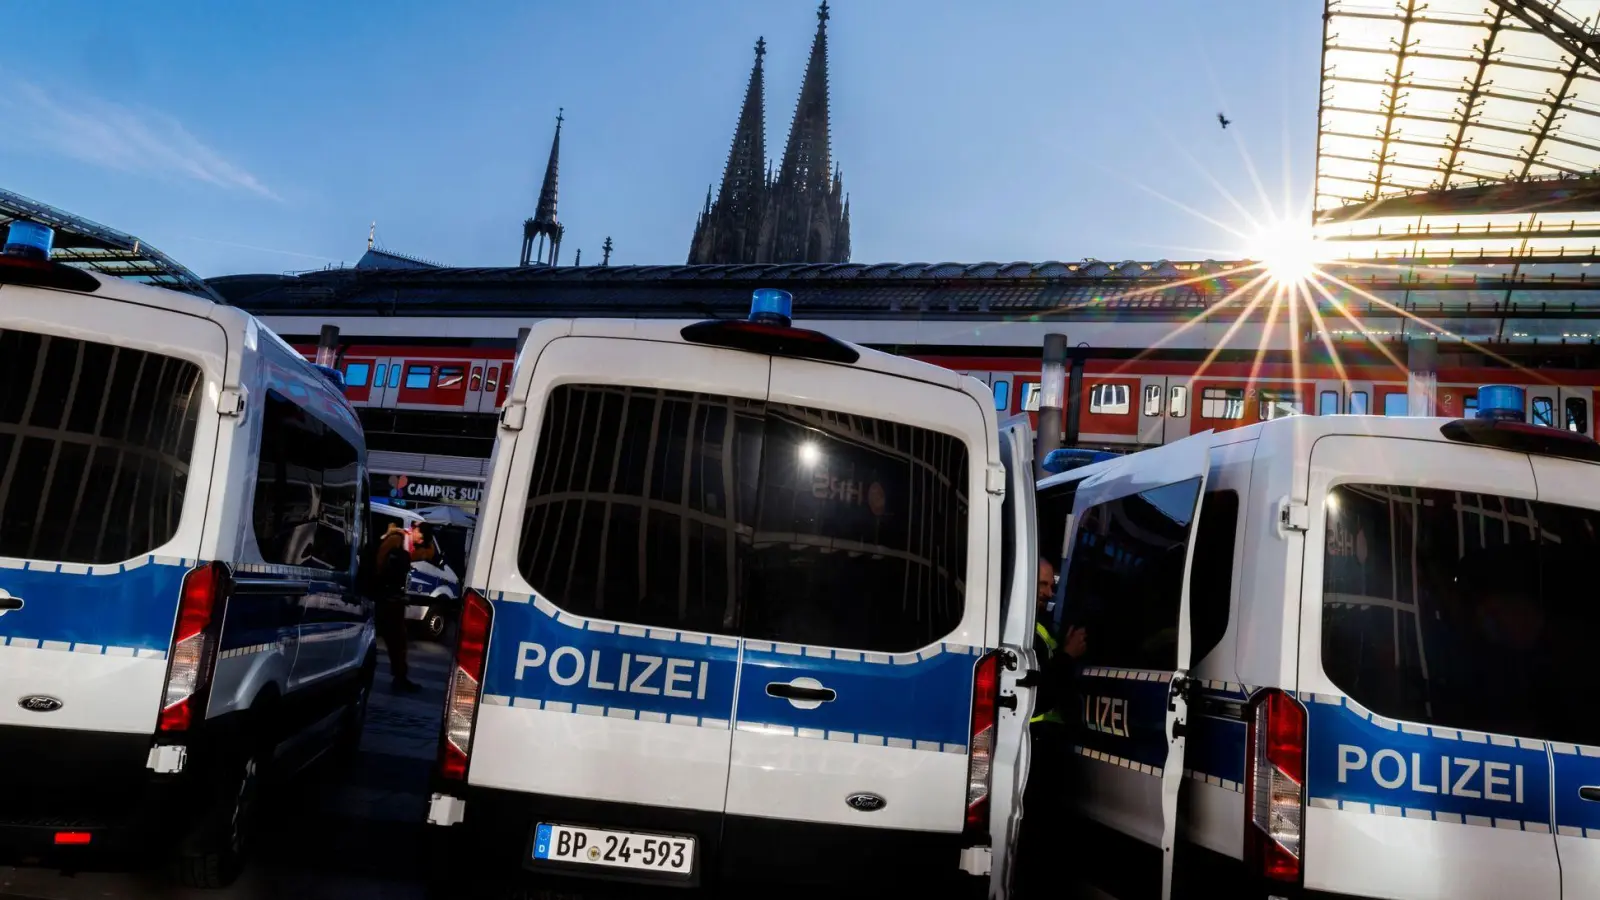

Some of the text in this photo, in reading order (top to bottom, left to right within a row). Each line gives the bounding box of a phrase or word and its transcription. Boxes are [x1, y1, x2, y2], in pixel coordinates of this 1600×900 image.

[1444, 394, 1452, 405] 2
[407, 482, 457, 499] CAMPUS
[514, 641, 709, 700] POLIZEI
[1080, 694, 1130, 738] LIZEI
[1337, 743, 1524, 804] POLIZEI
[538, 844, 545, 853] D
[556, 830, 686, 868] BP 24-593
